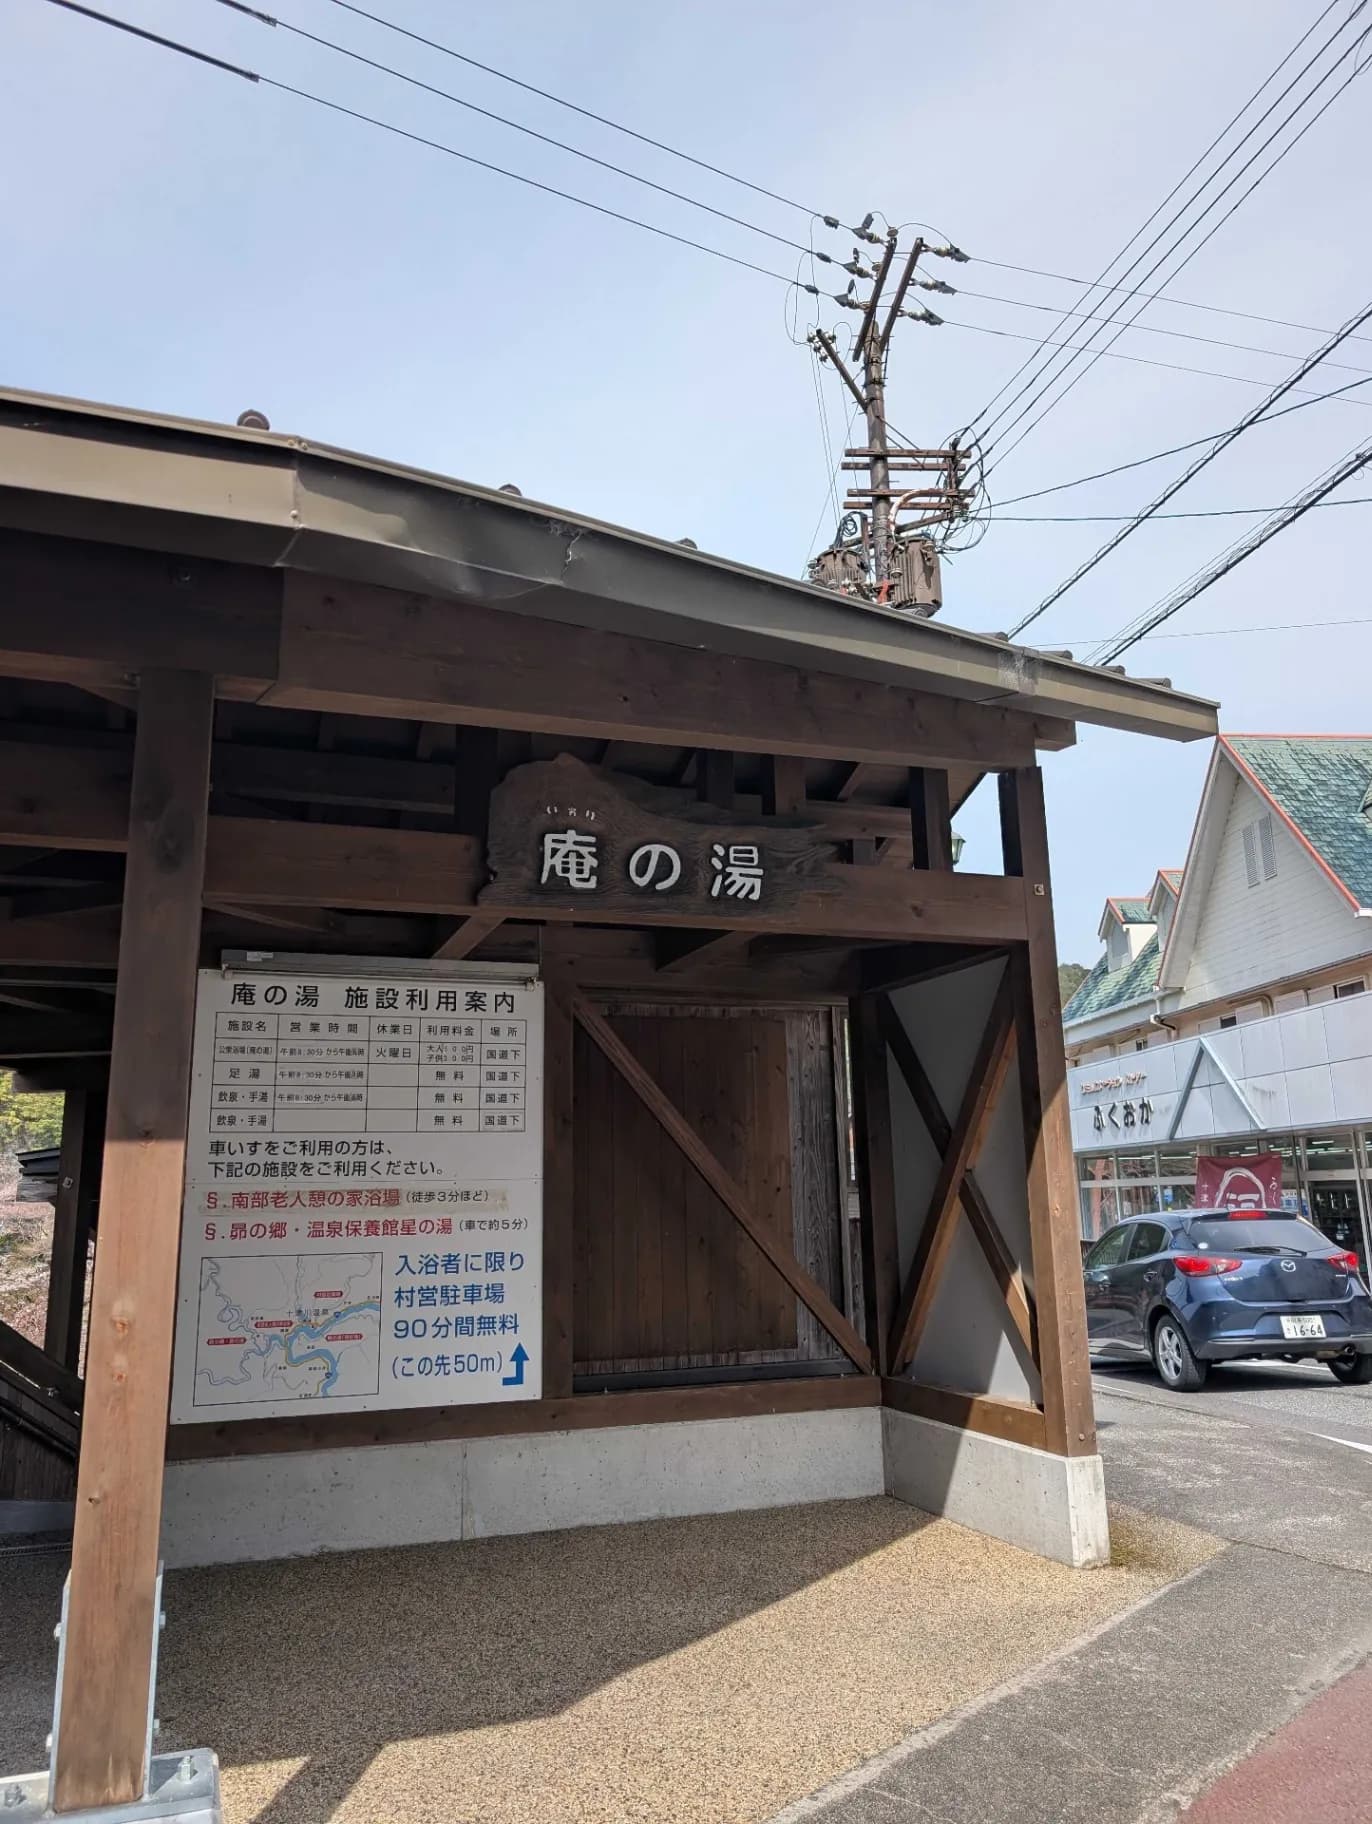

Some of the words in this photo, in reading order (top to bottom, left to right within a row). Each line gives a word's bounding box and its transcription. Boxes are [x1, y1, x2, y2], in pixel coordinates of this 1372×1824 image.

[540, 829, 765, 901] 庵の湯
[231, 982, 320, 1008] 庵の湯
[344, 986, 515, 1014] 施設利用案内
[227, 1020, 266, 1032] 施設名
[289, 1021, 358, 1034] 営業時間
[377, 1024, 412, 1035] 休業日
[426, 1024, 475, 1037] 利用料金
[490, 1026, 518, 1037] 場所
[376, 1047, 412, 1058] 火曜日
[486, 1049, 521, 1060] 国道下
[229, 1067, 260, 1079] 足湯
[435, 1071, 464, 1081] 無料
[485, 1071, 520, 1081] 国道下
[218, 1090, 268, 1103] 飲泉・手湯
[434, 1093, 463, 1103] 無料
[485, 1093, 520, 1103] 国道下
[216, 1114, 267, 1127] 飲泉・手湯
[434, 1115, 463, 1127] 無料
[485, 1115, 520, 1126] 国道下
[1093, 1096, 1154, 1132] ふくおか
[209, 1140, 393, 1157] 車いすをご利用の方は、
[208, 1160, 444, 1178] 下記の施設をご利用ください。
[395, 1251, 525, 1276] 入浴者に限り
[394, 1283, 505, 1308] 村営駐車場
[393, 1313, 520, 1339] 90分間無料
[1293, 1324, 1323, 1337] 16-64
[392, 1350, 503, 1379] (この先50m)
